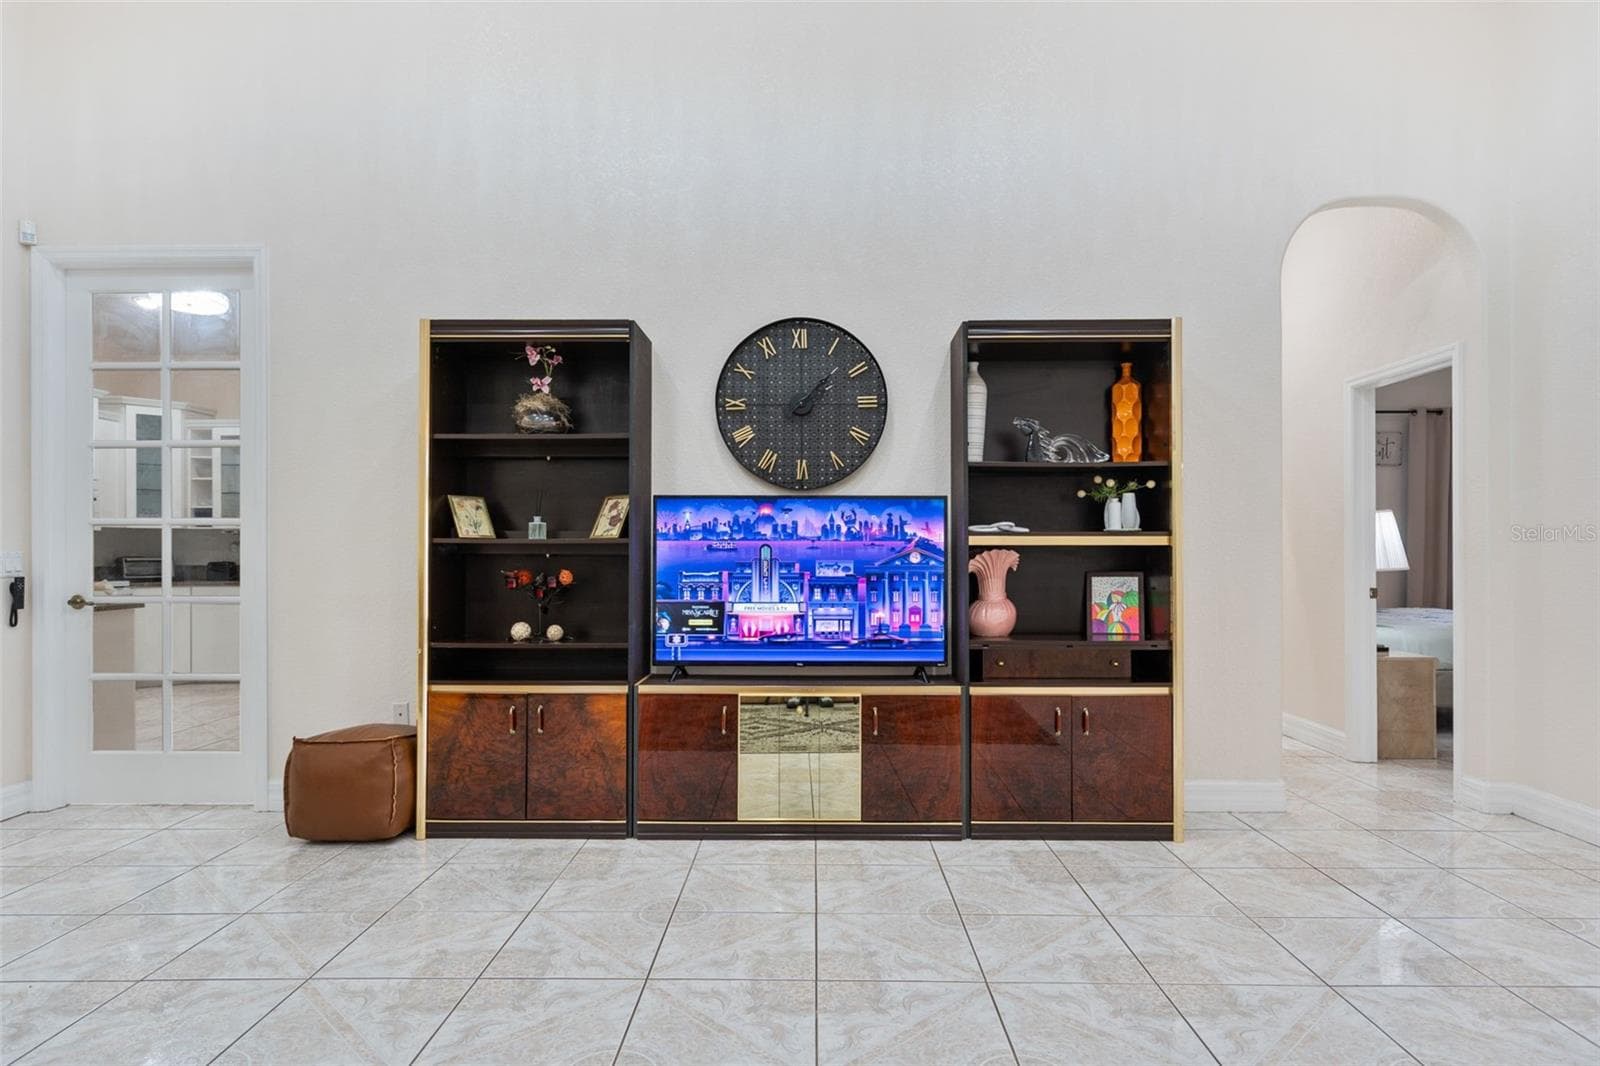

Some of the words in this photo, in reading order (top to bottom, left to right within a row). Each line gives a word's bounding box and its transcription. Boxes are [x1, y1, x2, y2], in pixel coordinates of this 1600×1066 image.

[792, 328, 808, 349] XII
[828, 337, 840, 355] I
[757, 336, 777, 359] XI
[734, 363, 756, 379] X
[848, 361, 868, 378] II
[857, 395, 878, 408] III
